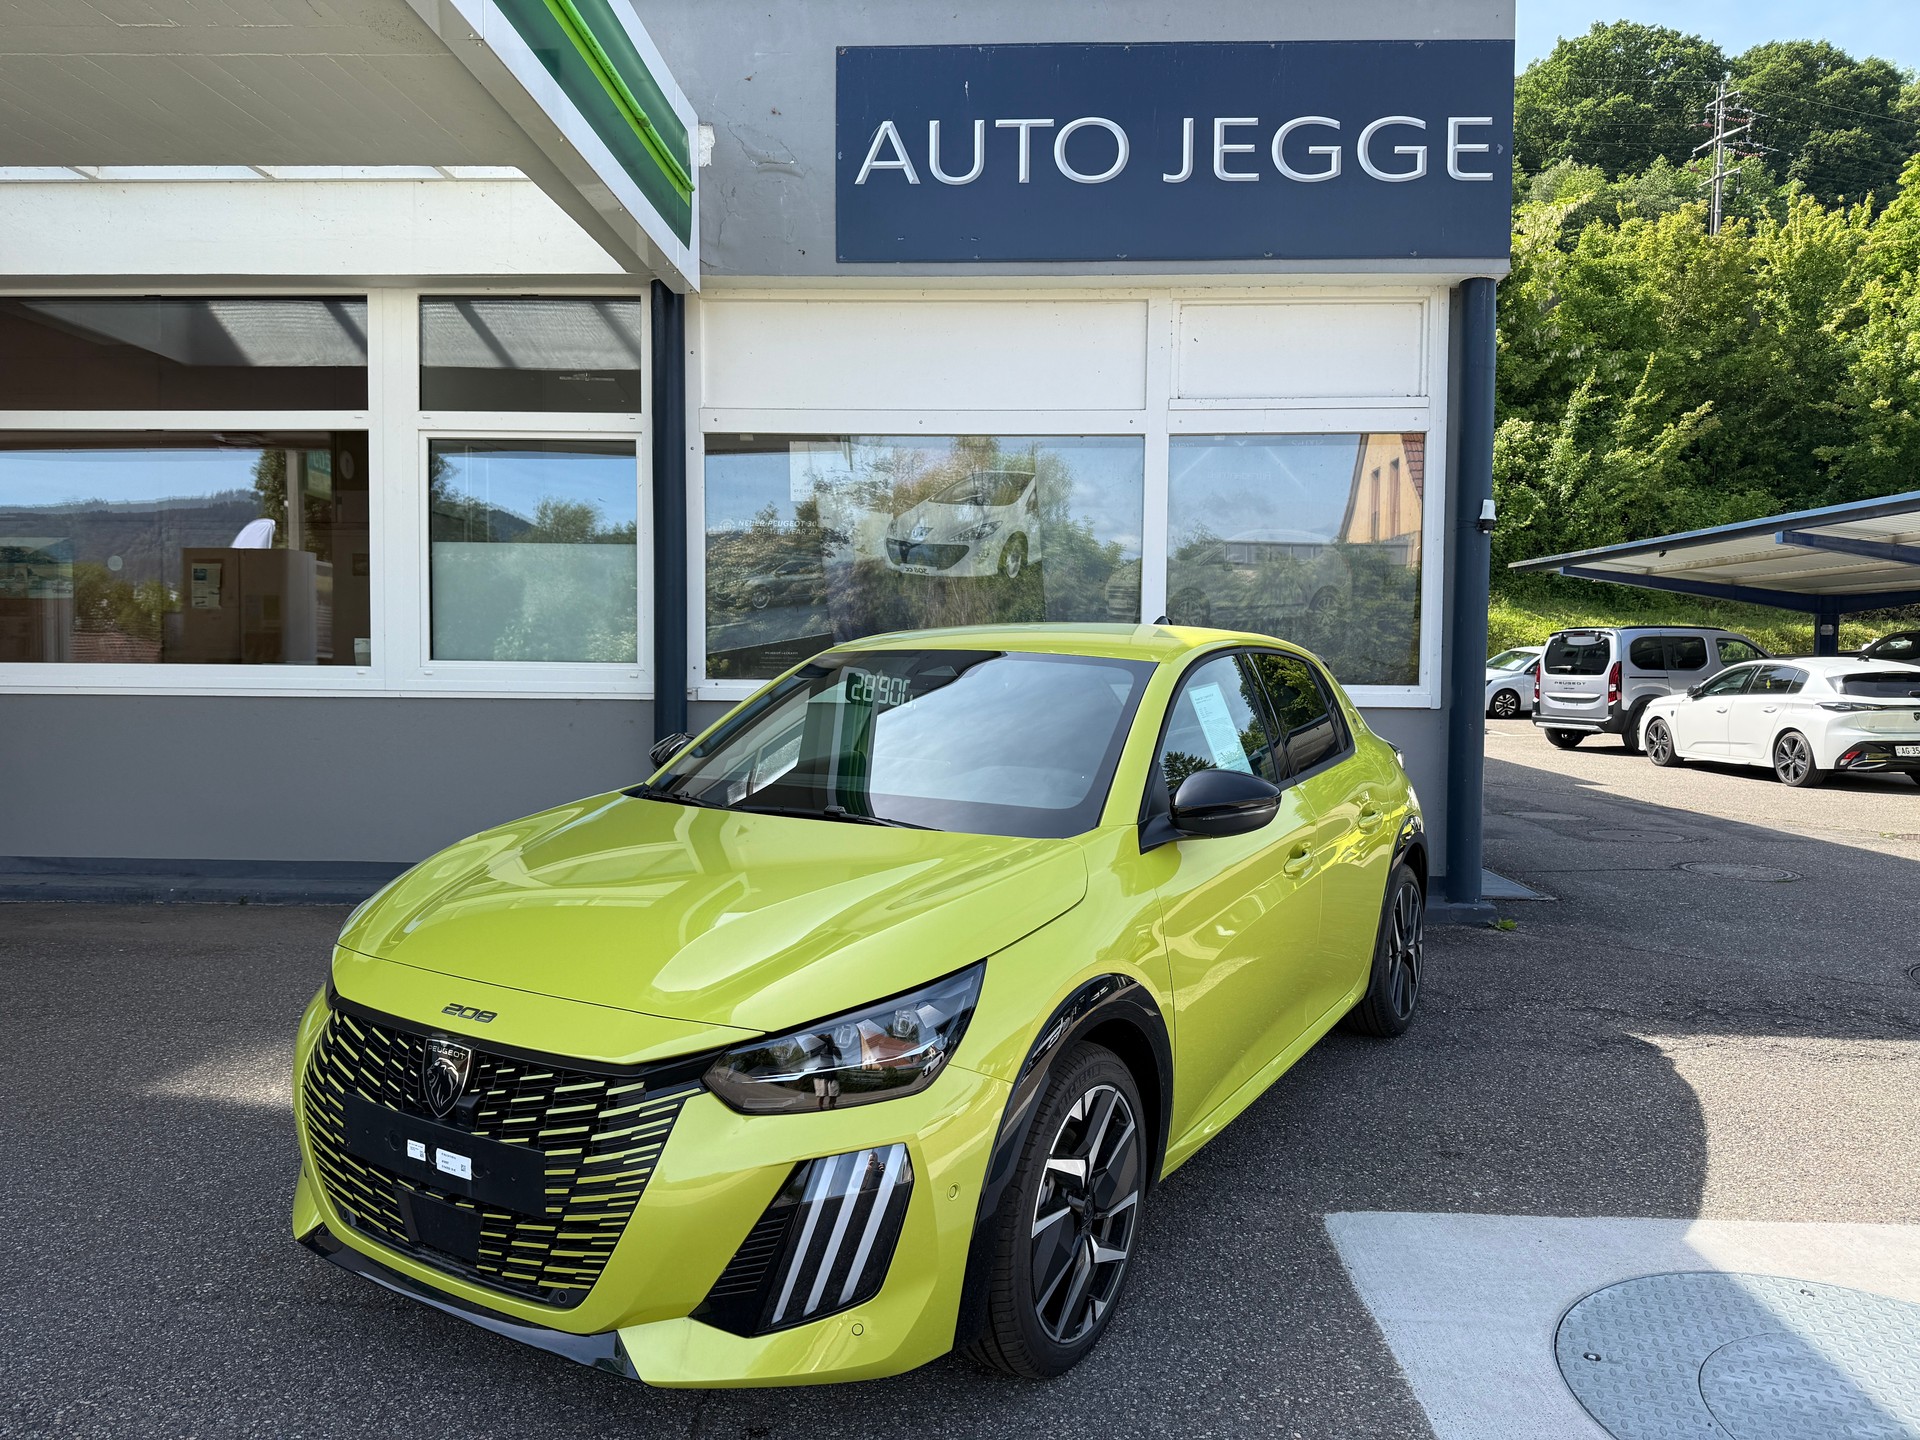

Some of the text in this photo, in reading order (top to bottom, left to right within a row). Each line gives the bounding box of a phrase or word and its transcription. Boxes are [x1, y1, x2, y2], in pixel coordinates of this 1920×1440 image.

[855, 116, 1494, 185] AUTO JEGGE
[1901, 747, 1910, 755] AG
[441, 1003, 498, 1024] 208
[428, 1044, 466, 1060] PEUGEOT
[1058, 1064, 1101, 1115] MICHELIN
